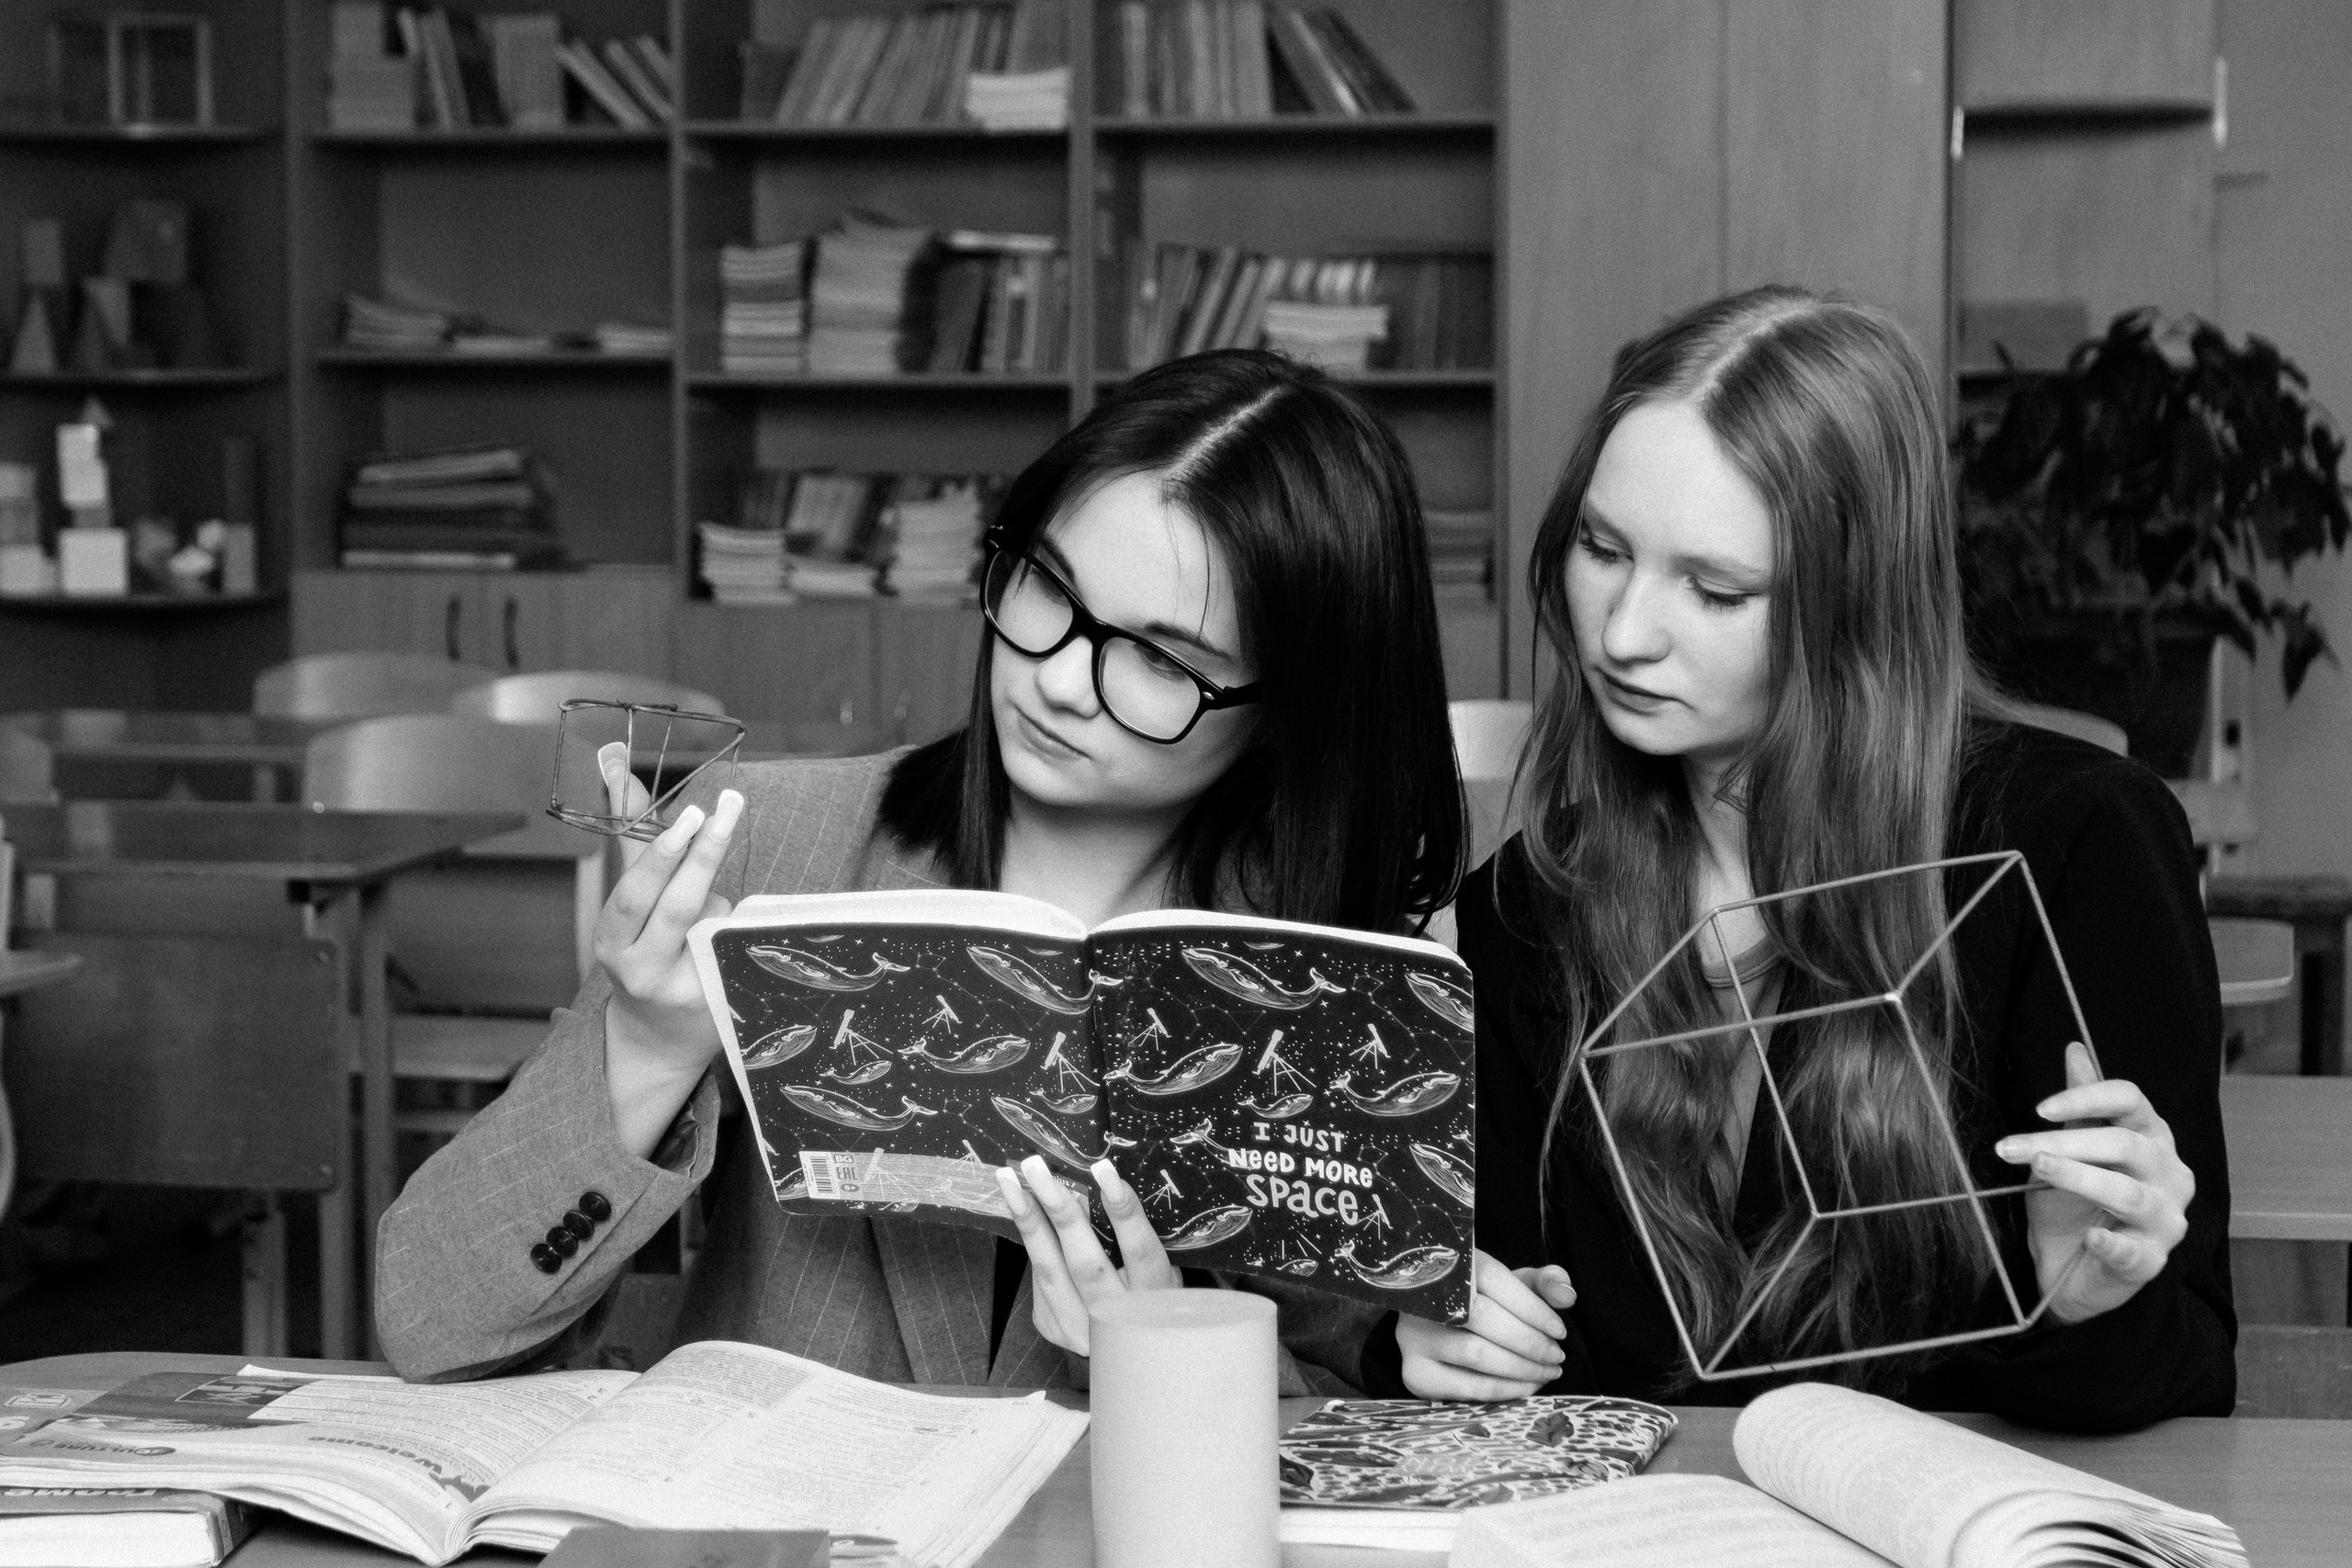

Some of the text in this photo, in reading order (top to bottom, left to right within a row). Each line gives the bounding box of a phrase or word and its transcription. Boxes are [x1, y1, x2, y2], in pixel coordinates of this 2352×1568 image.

[1253, 1122, 1345, 1152] I JUST
[835, 1155, 853, 1163] BG
